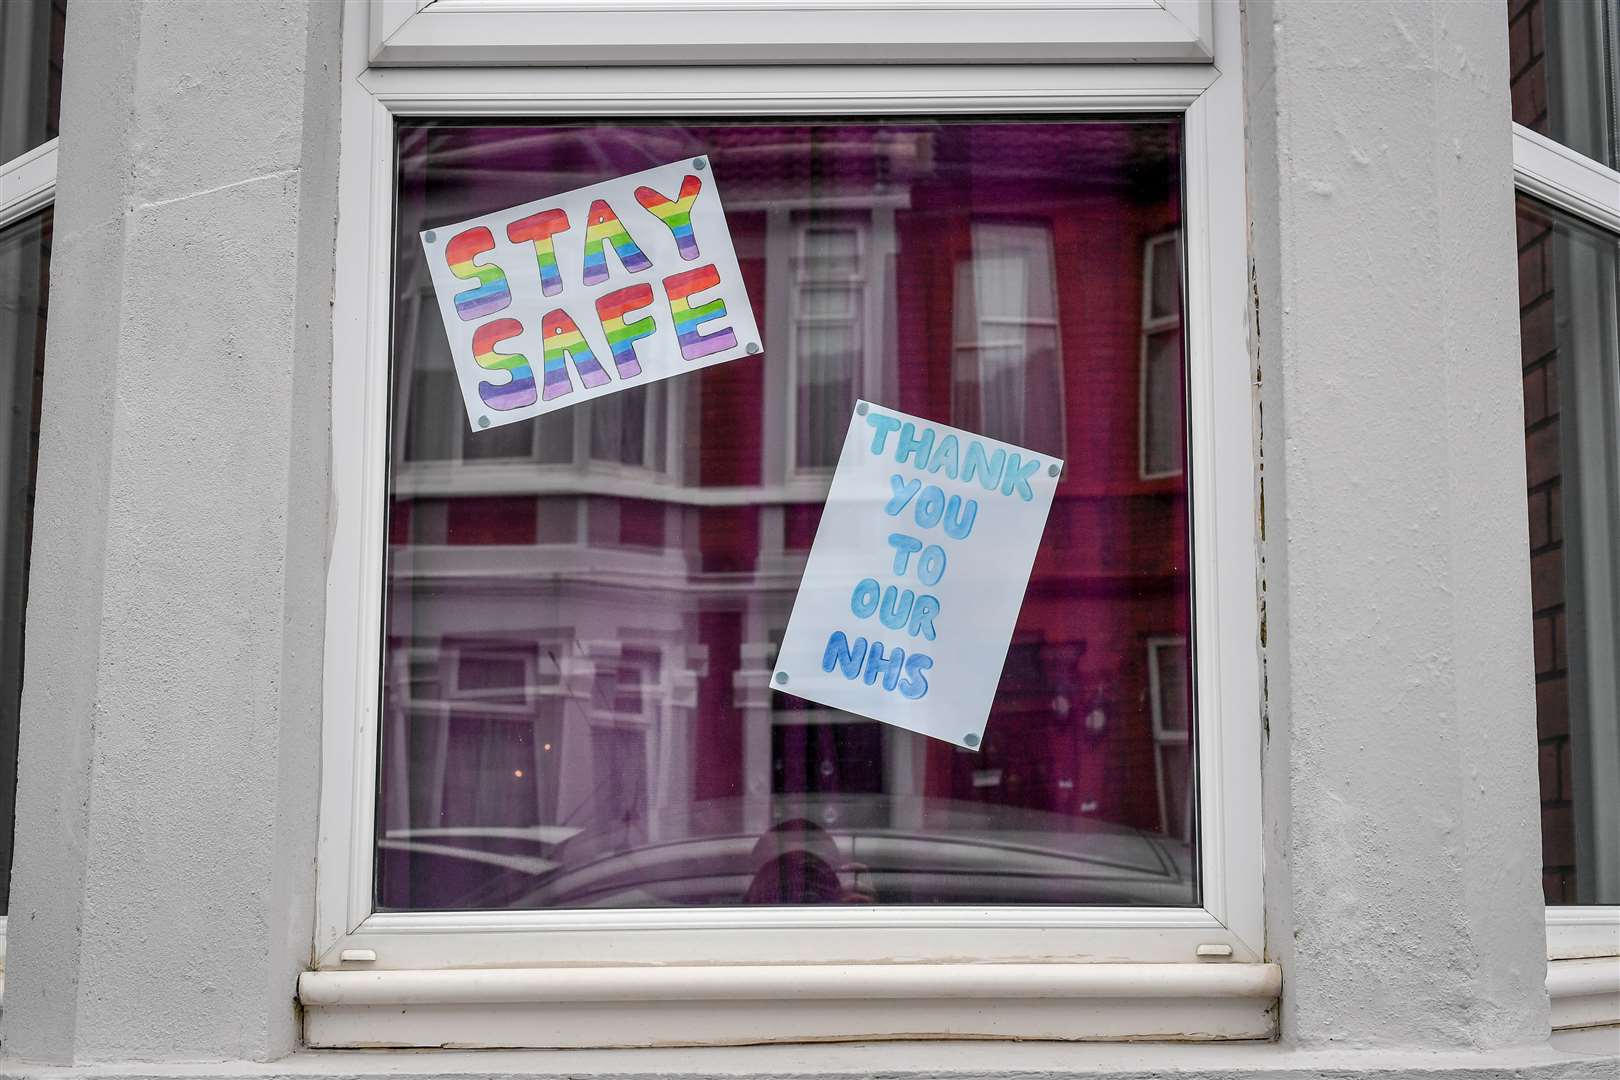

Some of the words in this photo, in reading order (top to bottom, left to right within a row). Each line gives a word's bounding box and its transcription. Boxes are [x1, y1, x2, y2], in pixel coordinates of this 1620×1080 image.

[445, 175, 702, 321] STAY
[472, 263, 738, 411] SAFE
[866, 412, 1040, 501] THANK
[884, 474, 978, 540] YOU
[888, 533, 947, 587] TO
[850, 578, 941, 641] OUR
[821, 630, 934, 700] NHS
